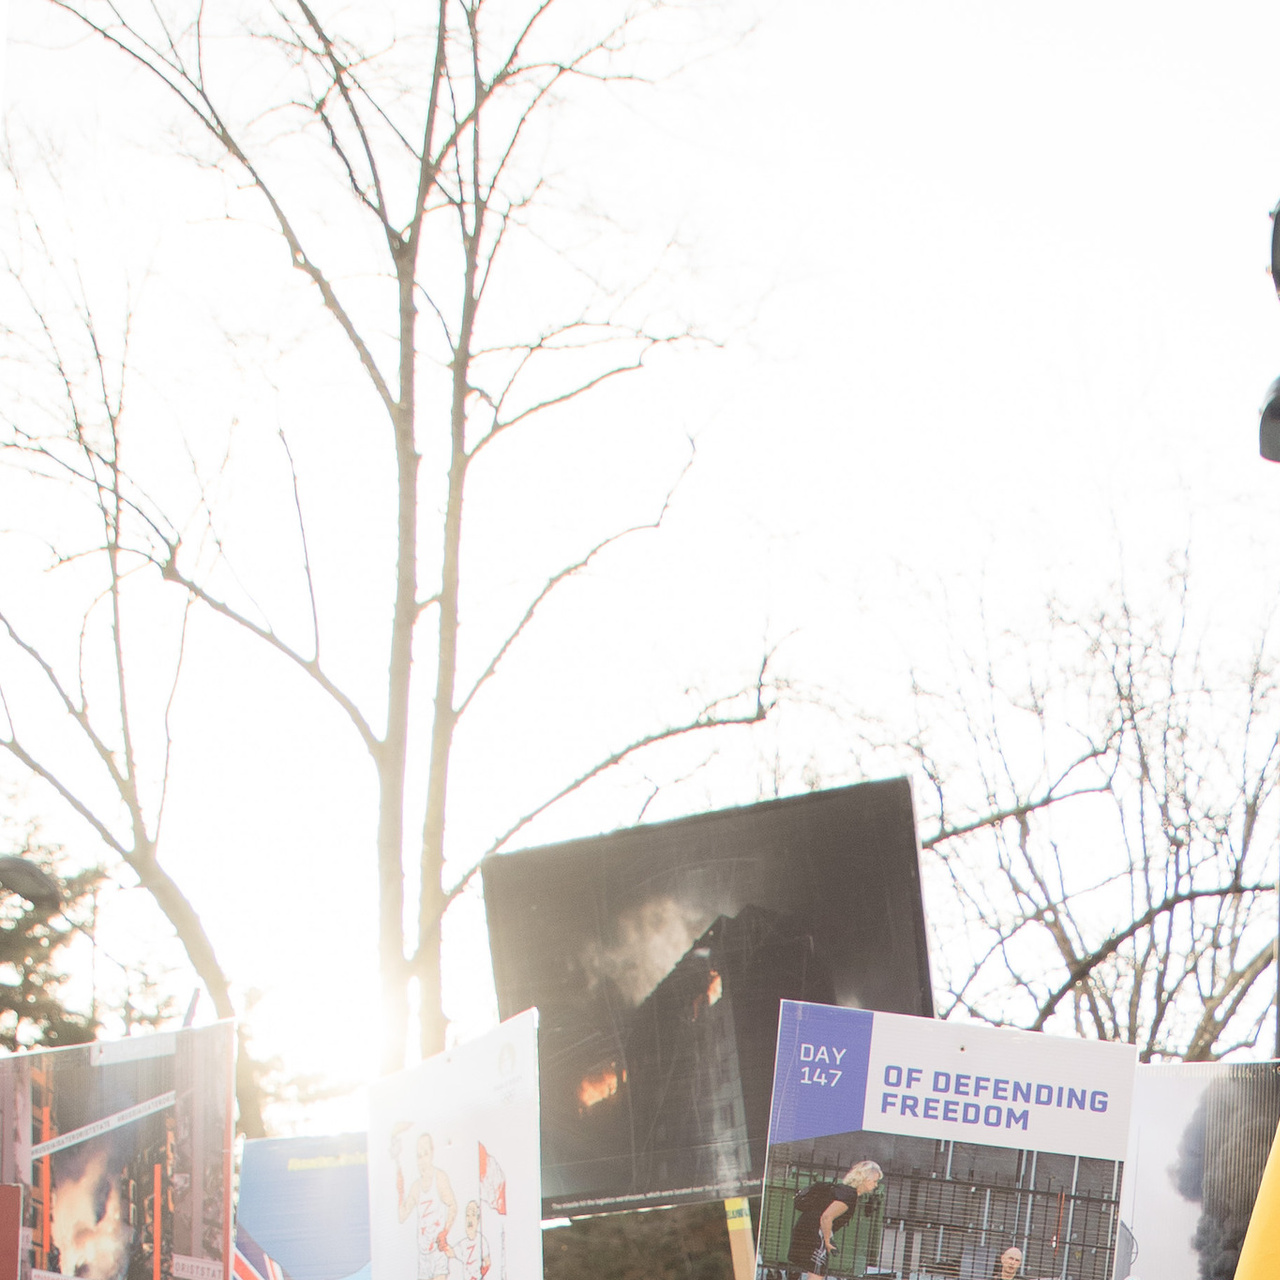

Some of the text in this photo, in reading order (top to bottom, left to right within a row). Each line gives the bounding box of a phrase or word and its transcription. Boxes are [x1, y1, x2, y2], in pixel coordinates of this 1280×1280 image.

[799, 1043, 847, 1066] DAY
[800, 1066, 843, 1088] 147
[884, 1065, 1109, 1114] OF DEFENDING
[881, 1092, 1030, 1131] FREEDOM
